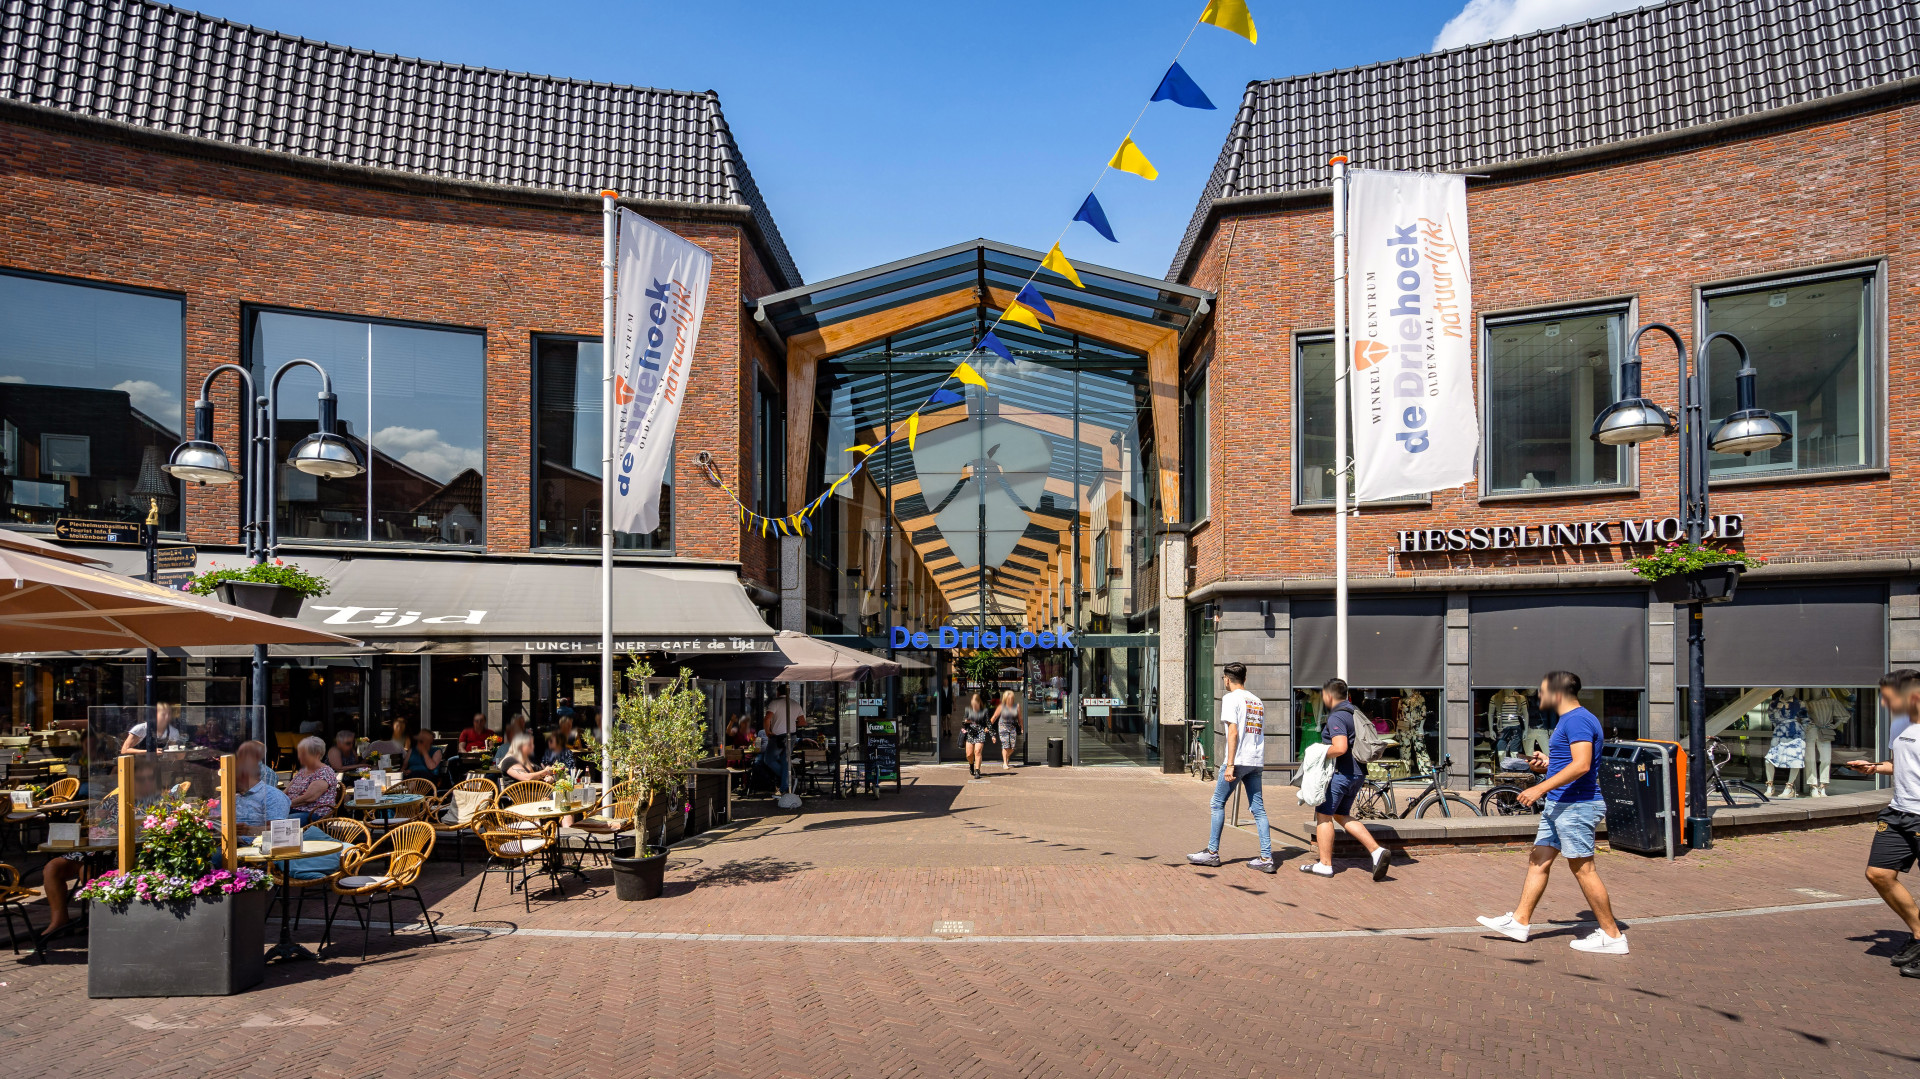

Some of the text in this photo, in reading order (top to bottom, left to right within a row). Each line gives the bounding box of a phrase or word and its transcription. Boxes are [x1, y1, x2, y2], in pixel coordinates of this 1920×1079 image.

[1418, 217, 1463, 338] natuurlijk!
[1366, 271, 1382, 424] WINKEL CENTRUM
[1387, 223, 1430, 454] de Driehoek
[1427, 317, 1439, 397] OLDENZAAL
[617, 277, 671, 496] de Driehoek
[1396, 522, 1612, 552] HESSELINK
[310, 605, 488, 628] Tijd
[525, 642, 582, 651] LUNCH
[597, 641, 646, 650] DNER
[661, 639, 701, 650] CAFÉ
[707, 639, 726, 649] de
[890, 626, 1075, 649] De Driehoek
